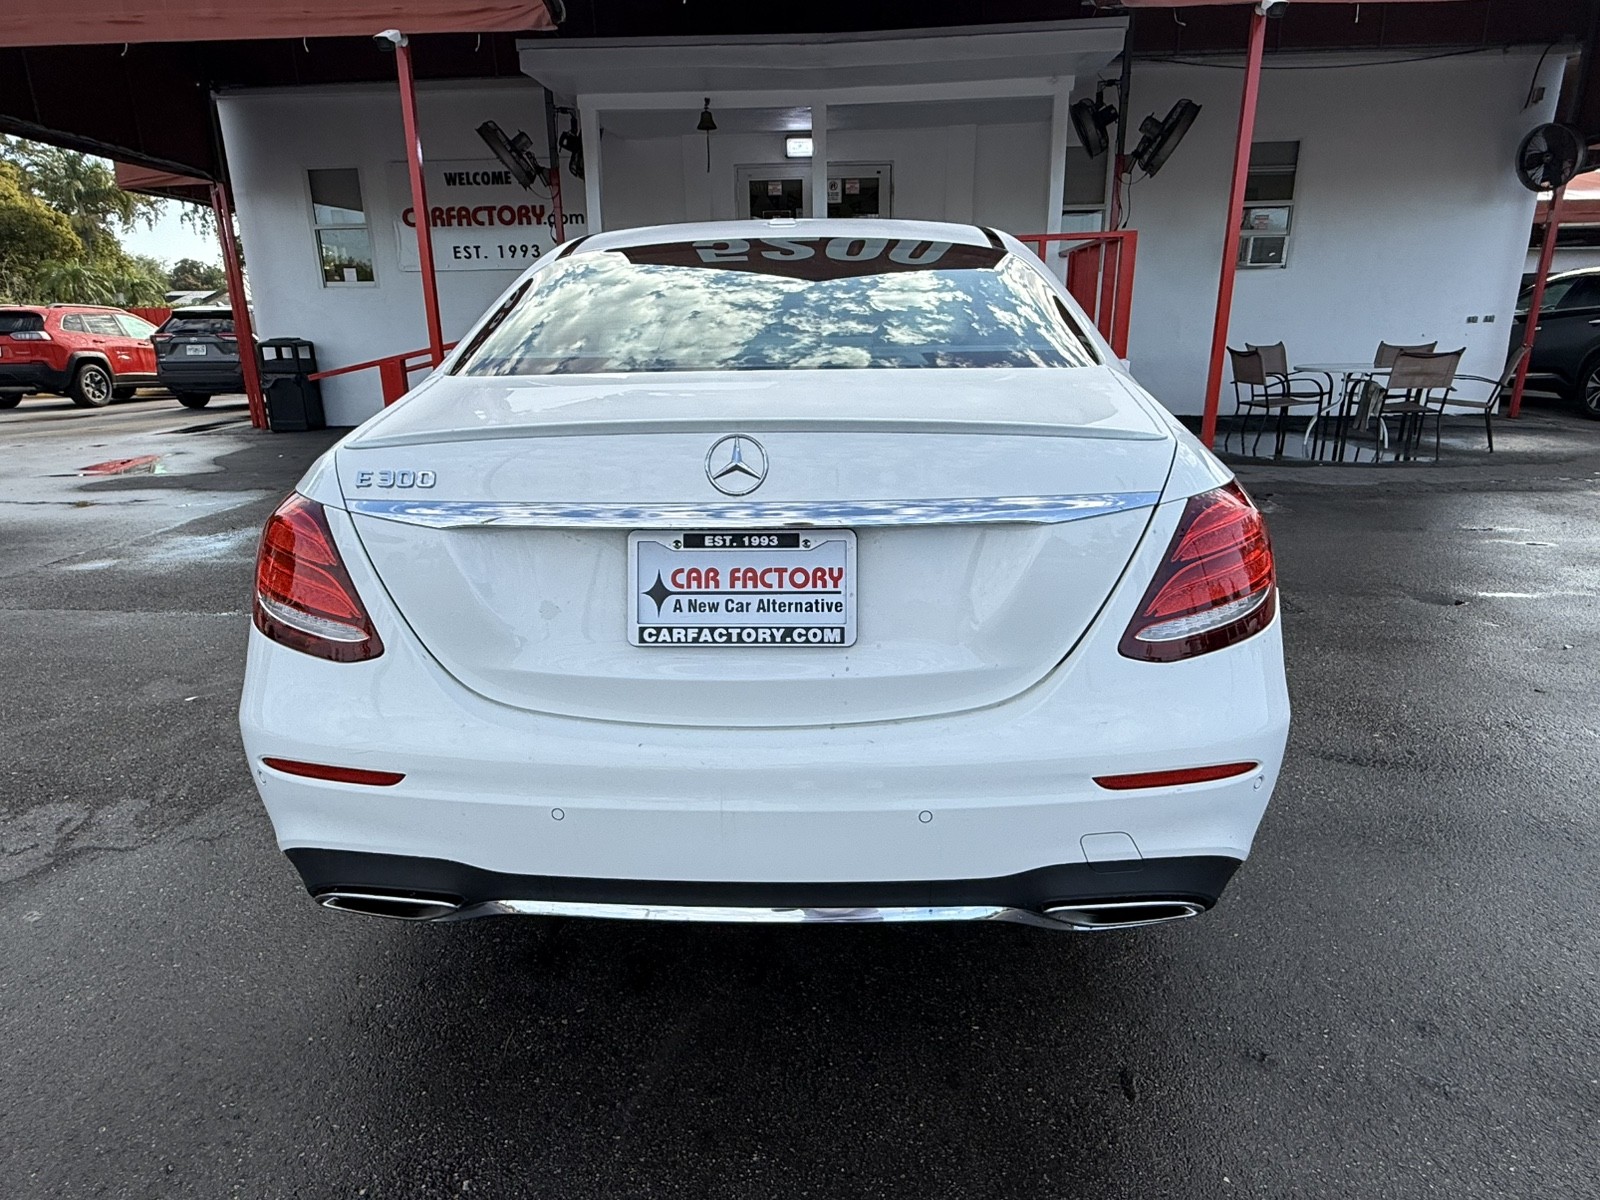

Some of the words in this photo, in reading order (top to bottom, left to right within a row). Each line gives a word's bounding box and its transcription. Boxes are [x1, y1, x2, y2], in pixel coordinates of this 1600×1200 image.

[444, 171, 512, 186] WELCOME
[402, 204, 585, 228] CRFACTORY.com
[453, 245, 489, 260] EST.
[497, 244, 541, 259] 1993
[356, 470, 374, 489] E
[377, 470, 437, 489] 300
[704, 536, 737, 546] EST.
[742, 536, 779, 546] 1993
[671, 567, 720, 589] CAR
[729, 567, 844, 589] FACTORY
[673, 599, 683, 613] A
[688, 599, 720, 613] New
[725, 599, 751, 613] Car
[756, 599, 843, 613] Alternative
[643, 628, 841, 643] CARFACTORY.COM
